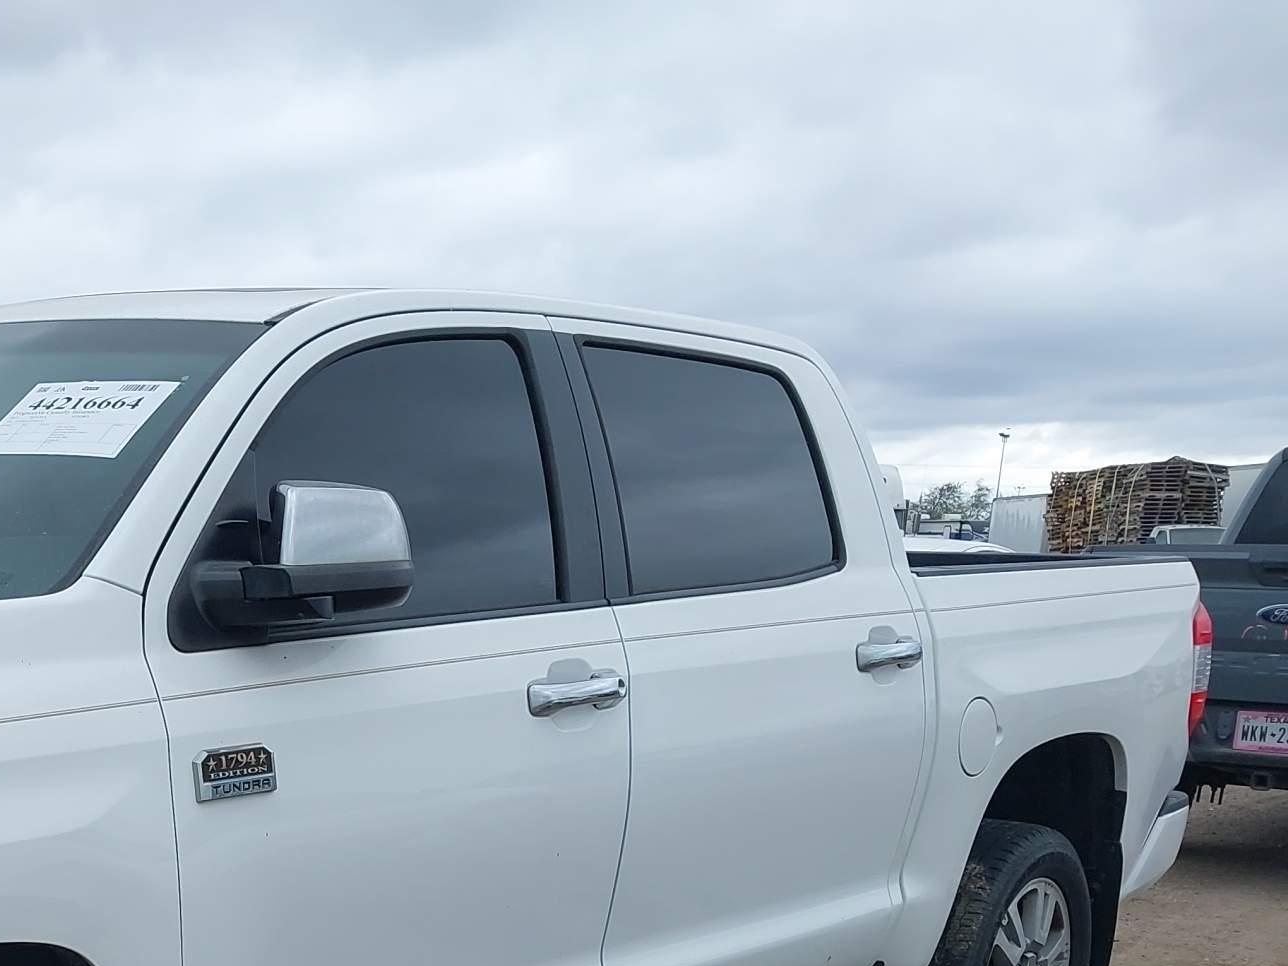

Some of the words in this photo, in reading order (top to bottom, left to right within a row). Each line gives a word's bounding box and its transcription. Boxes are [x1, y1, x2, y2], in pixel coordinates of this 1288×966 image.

[28, 396, 144, 410] 44216664
[1270, 608, 1288, 623] Fo
[1264, 715, 1288, 724] TEXA
[219, 751, 256, 770] 1794
[210, 765, 268, 780] EDITION
[212, 779, 272, 795] TUNDRA
